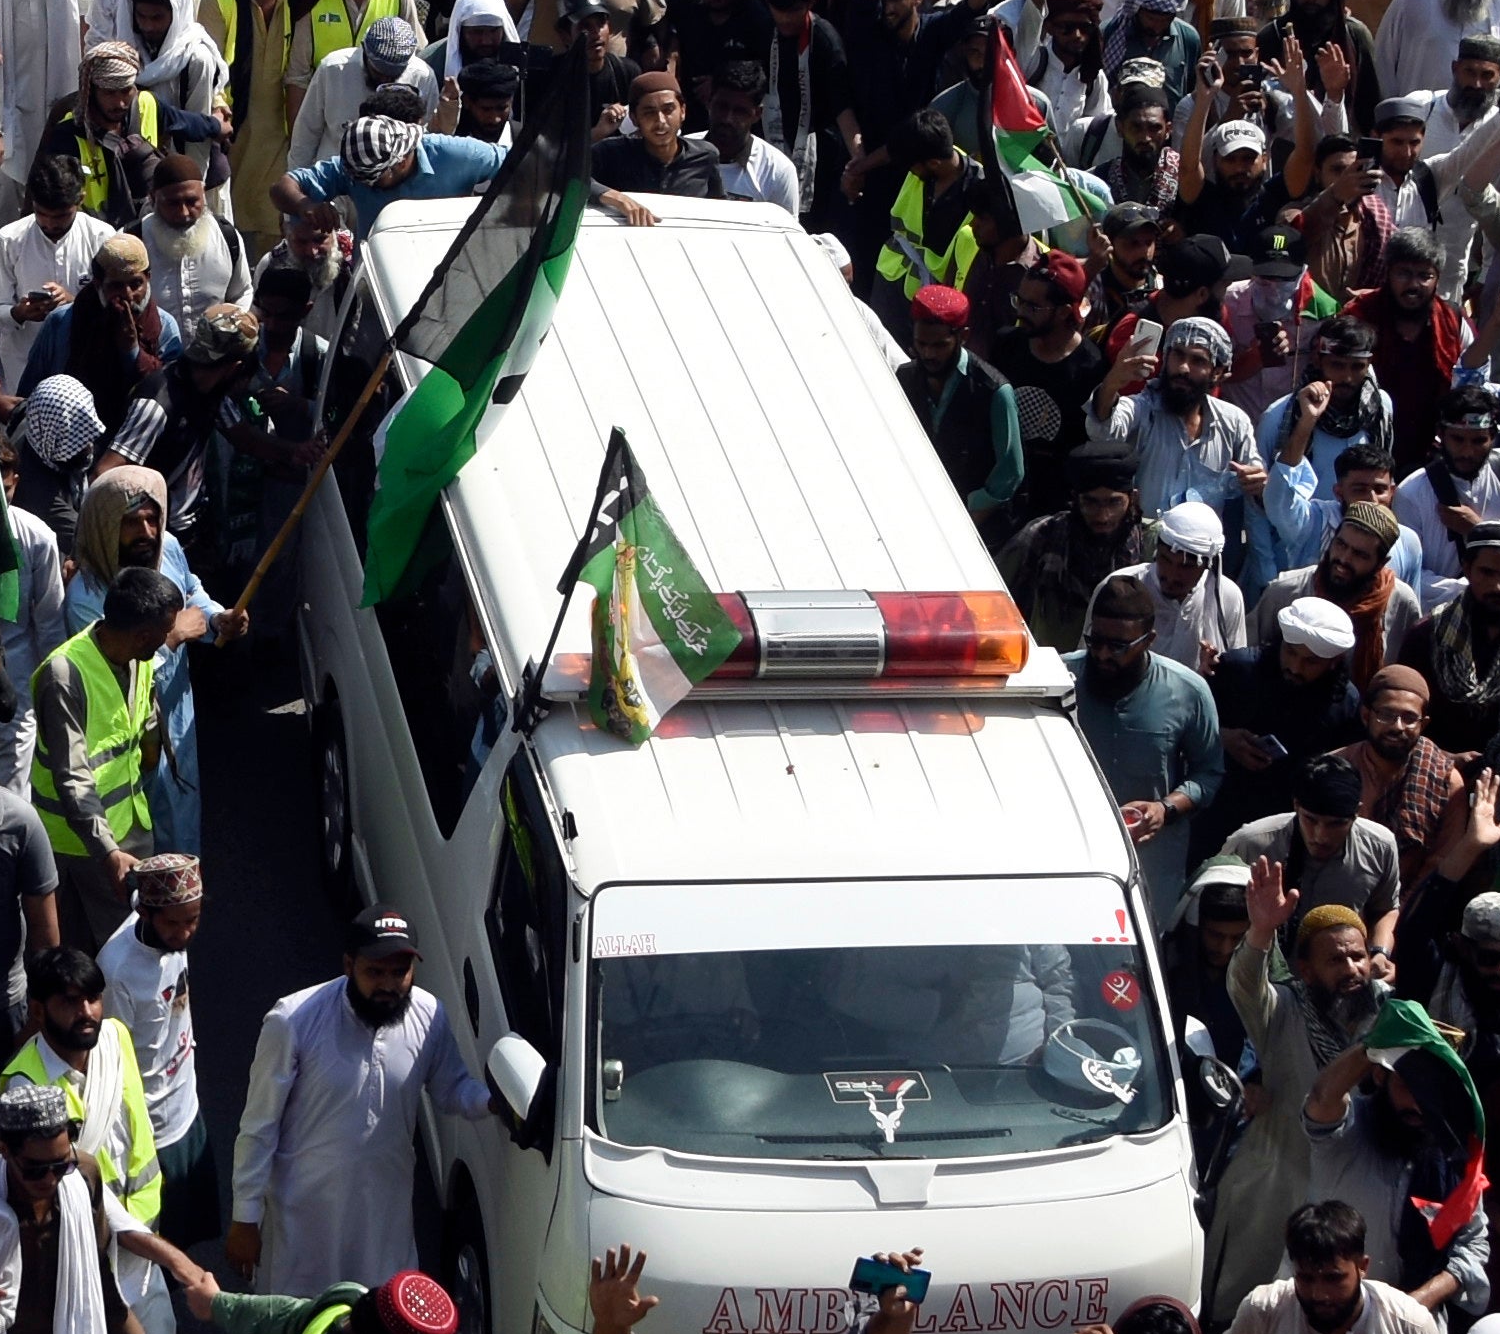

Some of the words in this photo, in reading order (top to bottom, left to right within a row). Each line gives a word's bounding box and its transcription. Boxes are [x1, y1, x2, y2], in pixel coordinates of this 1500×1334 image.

[631, 544, 673, 590] پاکستان
[656, 578, 690, 622] لبیک
[674, 613, 712, 658] تحریک
[593, 934, 657, 957] ALLAH
